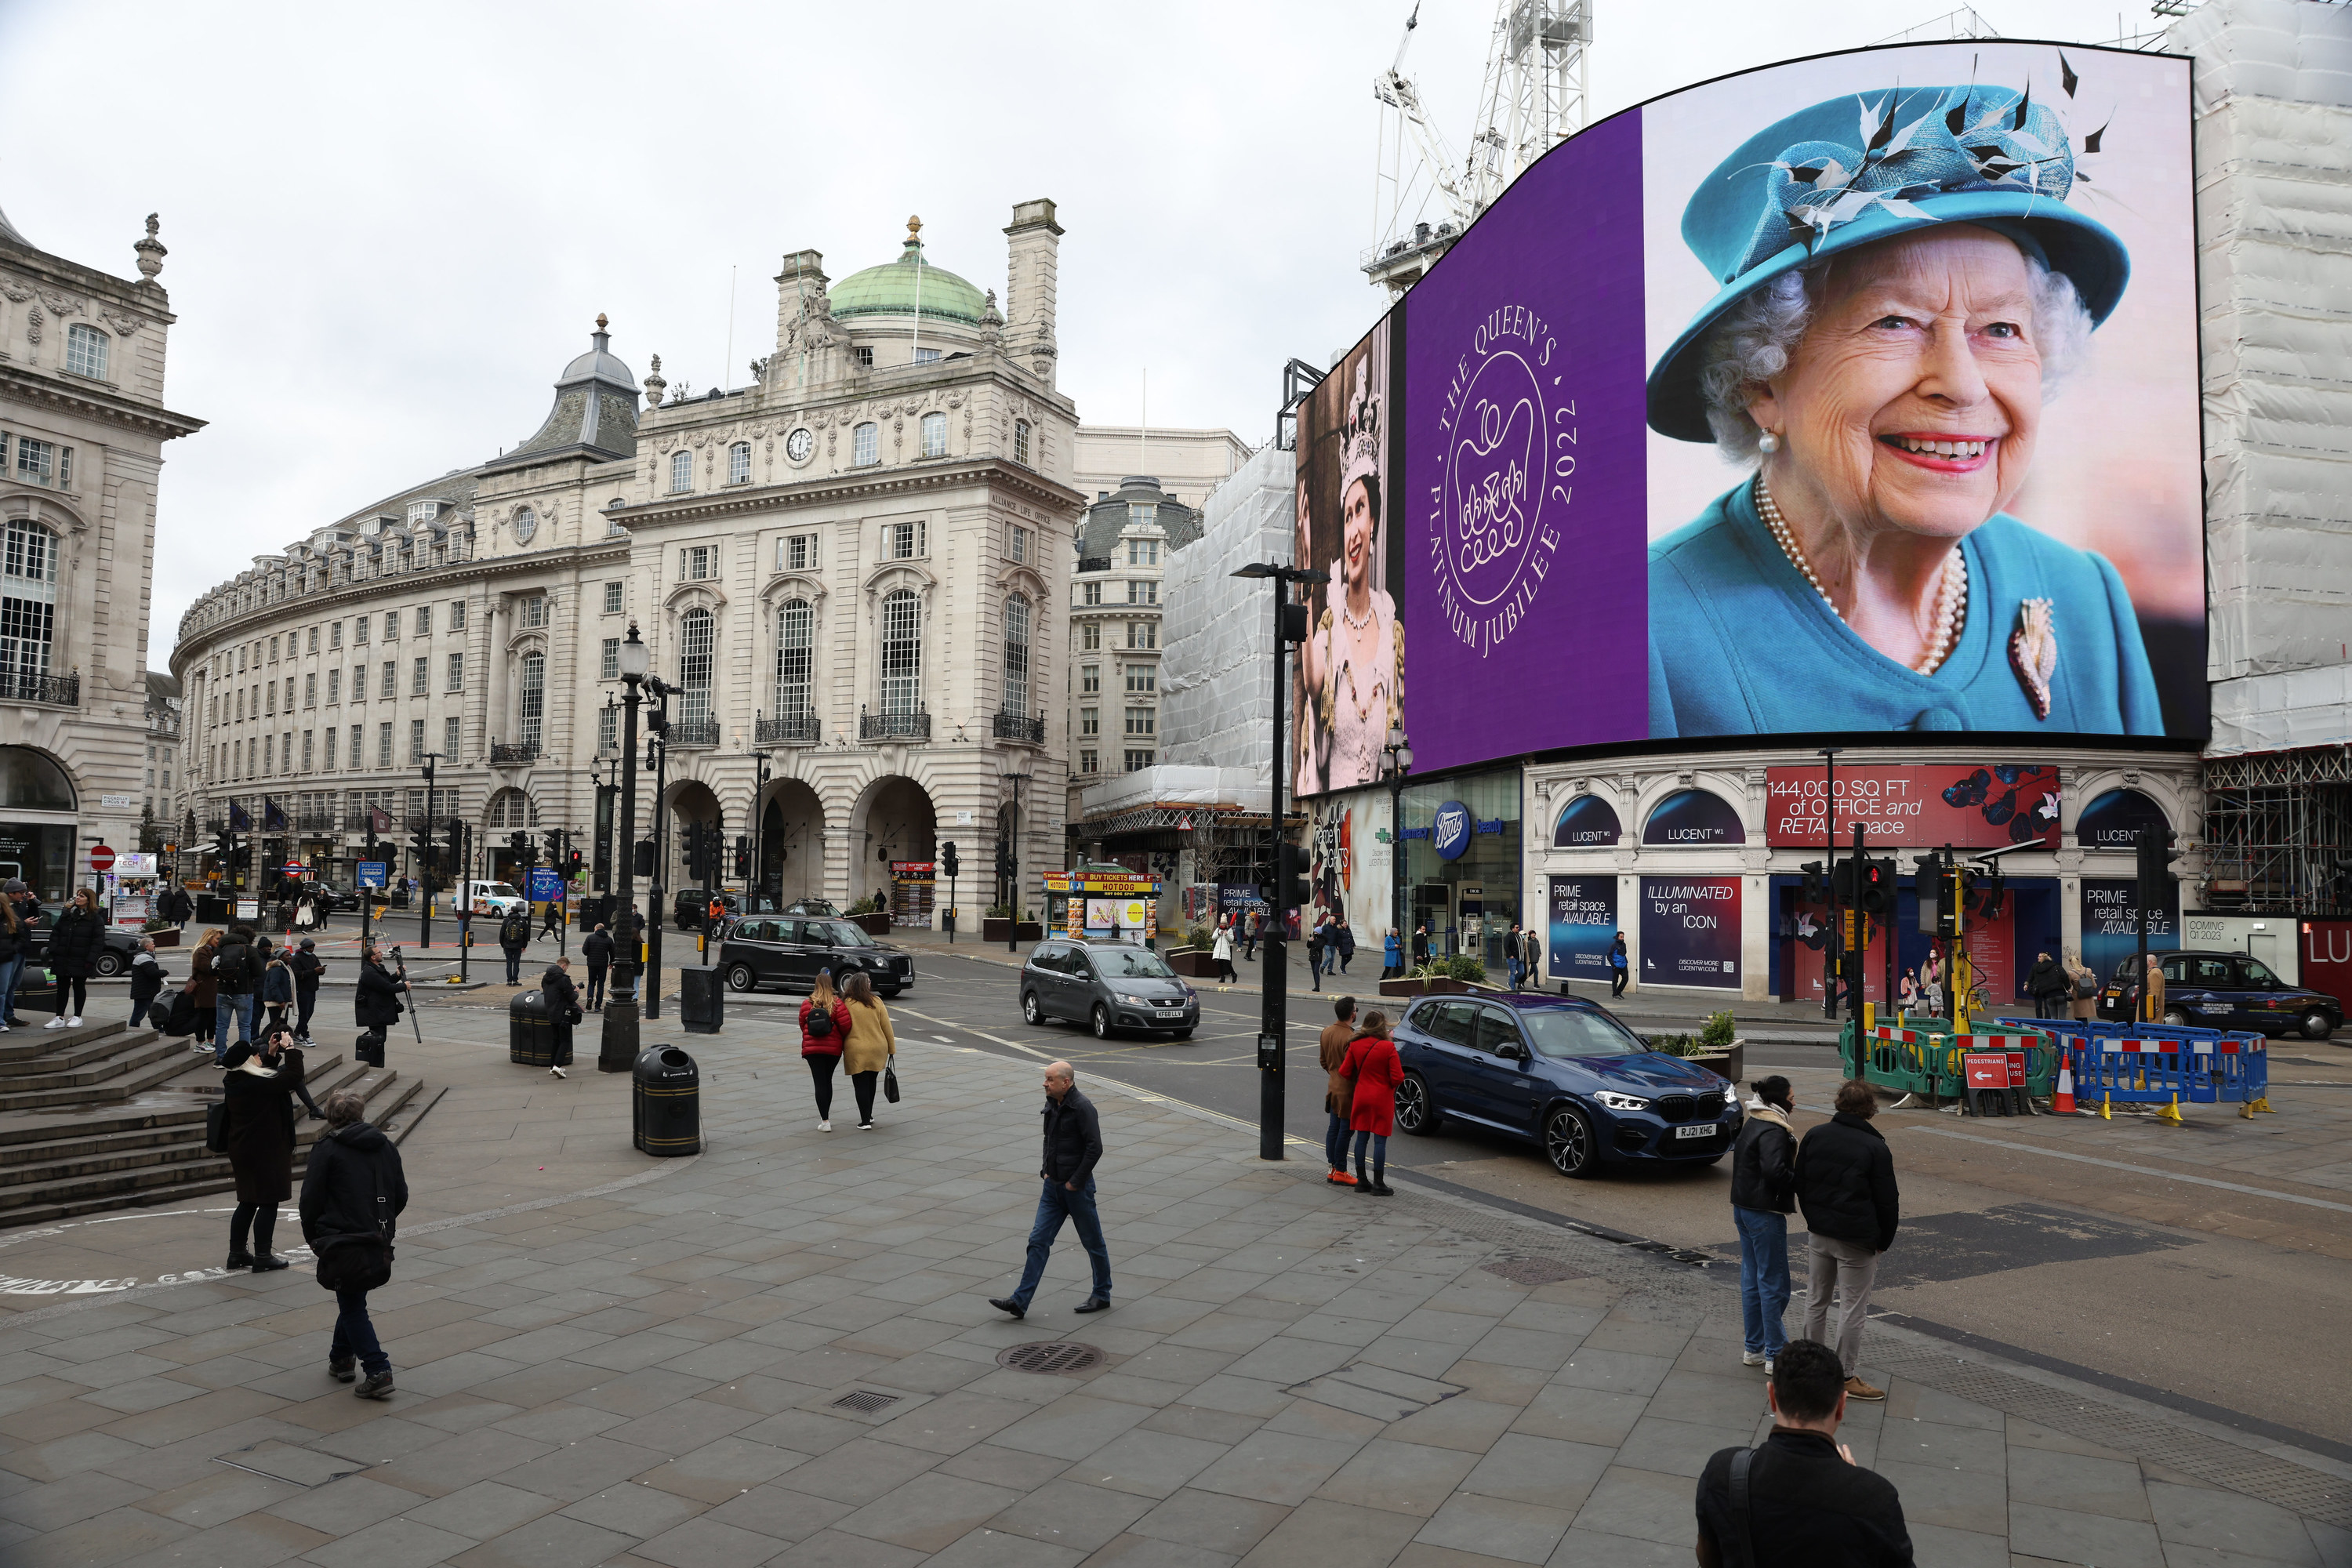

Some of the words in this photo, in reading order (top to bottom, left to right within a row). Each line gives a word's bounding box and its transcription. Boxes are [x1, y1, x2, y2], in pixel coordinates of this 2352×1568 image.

[1439, 354, 1468, 432] THE
[1475, 305, 1556, 366] QUEEN'S
[992, 494, 1016, 511] ALLIANCE
[1020, 506, 1031, 517] LIFE
[1035, 512, 1051, 524] OFFICE
[1429, 486, 1476, 648] PLATINUM
[1483, 523, 1560, 659] JUBILEE
[1552, 399, 1577, 504] 2022
[1850, 779, 1880, 797] SQ
[1886, 780, 1910, 797] FT
[1789, 799, 1806, 815] of
[1886, 799, 1922, 815] and
[1435, 810, 1463, 850] Boots
[1476, 817, 1504, 836] beauty
[1779, 818, 1842, 834] RETAL
[1399, 827, 1429, 842] pharmacy
[1573, 831, 1602, 842] LUCENT
[1668, 829, 1712, 840] LUCENT
[1223, 889, 1250, 898] PRIME
[1554, 885, 1581, 898] PRIME
[1647, 886, 1733, 900] ILLUMINATED
[2087, 890, 2127, 904] PRIME
[1227, 908, 1271, 916] AVILBLE
[1559, 899, 1577, 911] retail
[1579, 902, 1606, 913] space
[1655, 900, 1669, 916] by
[1671, 903, 1687, 913] an
[1562, 912, 1611, 926] AVAILABLE
[2094, 906, 2122, 920] retail
[2125, 909, 2163, 922] spce
[1683, 915, 1717, 929] ICON
[2100, 920, 2170, 935] AVAILBLE
[2189, 920, 2224, 931] COMING
[2190, 930, 2199, 940] Q1
[2201, 931, 2222, 941] 2023
[2309, 929, 2351, 964] LU
[1681, 1127, 1698, 1138] RJ21
[1699, 1125, 1712, 1135] XHG
